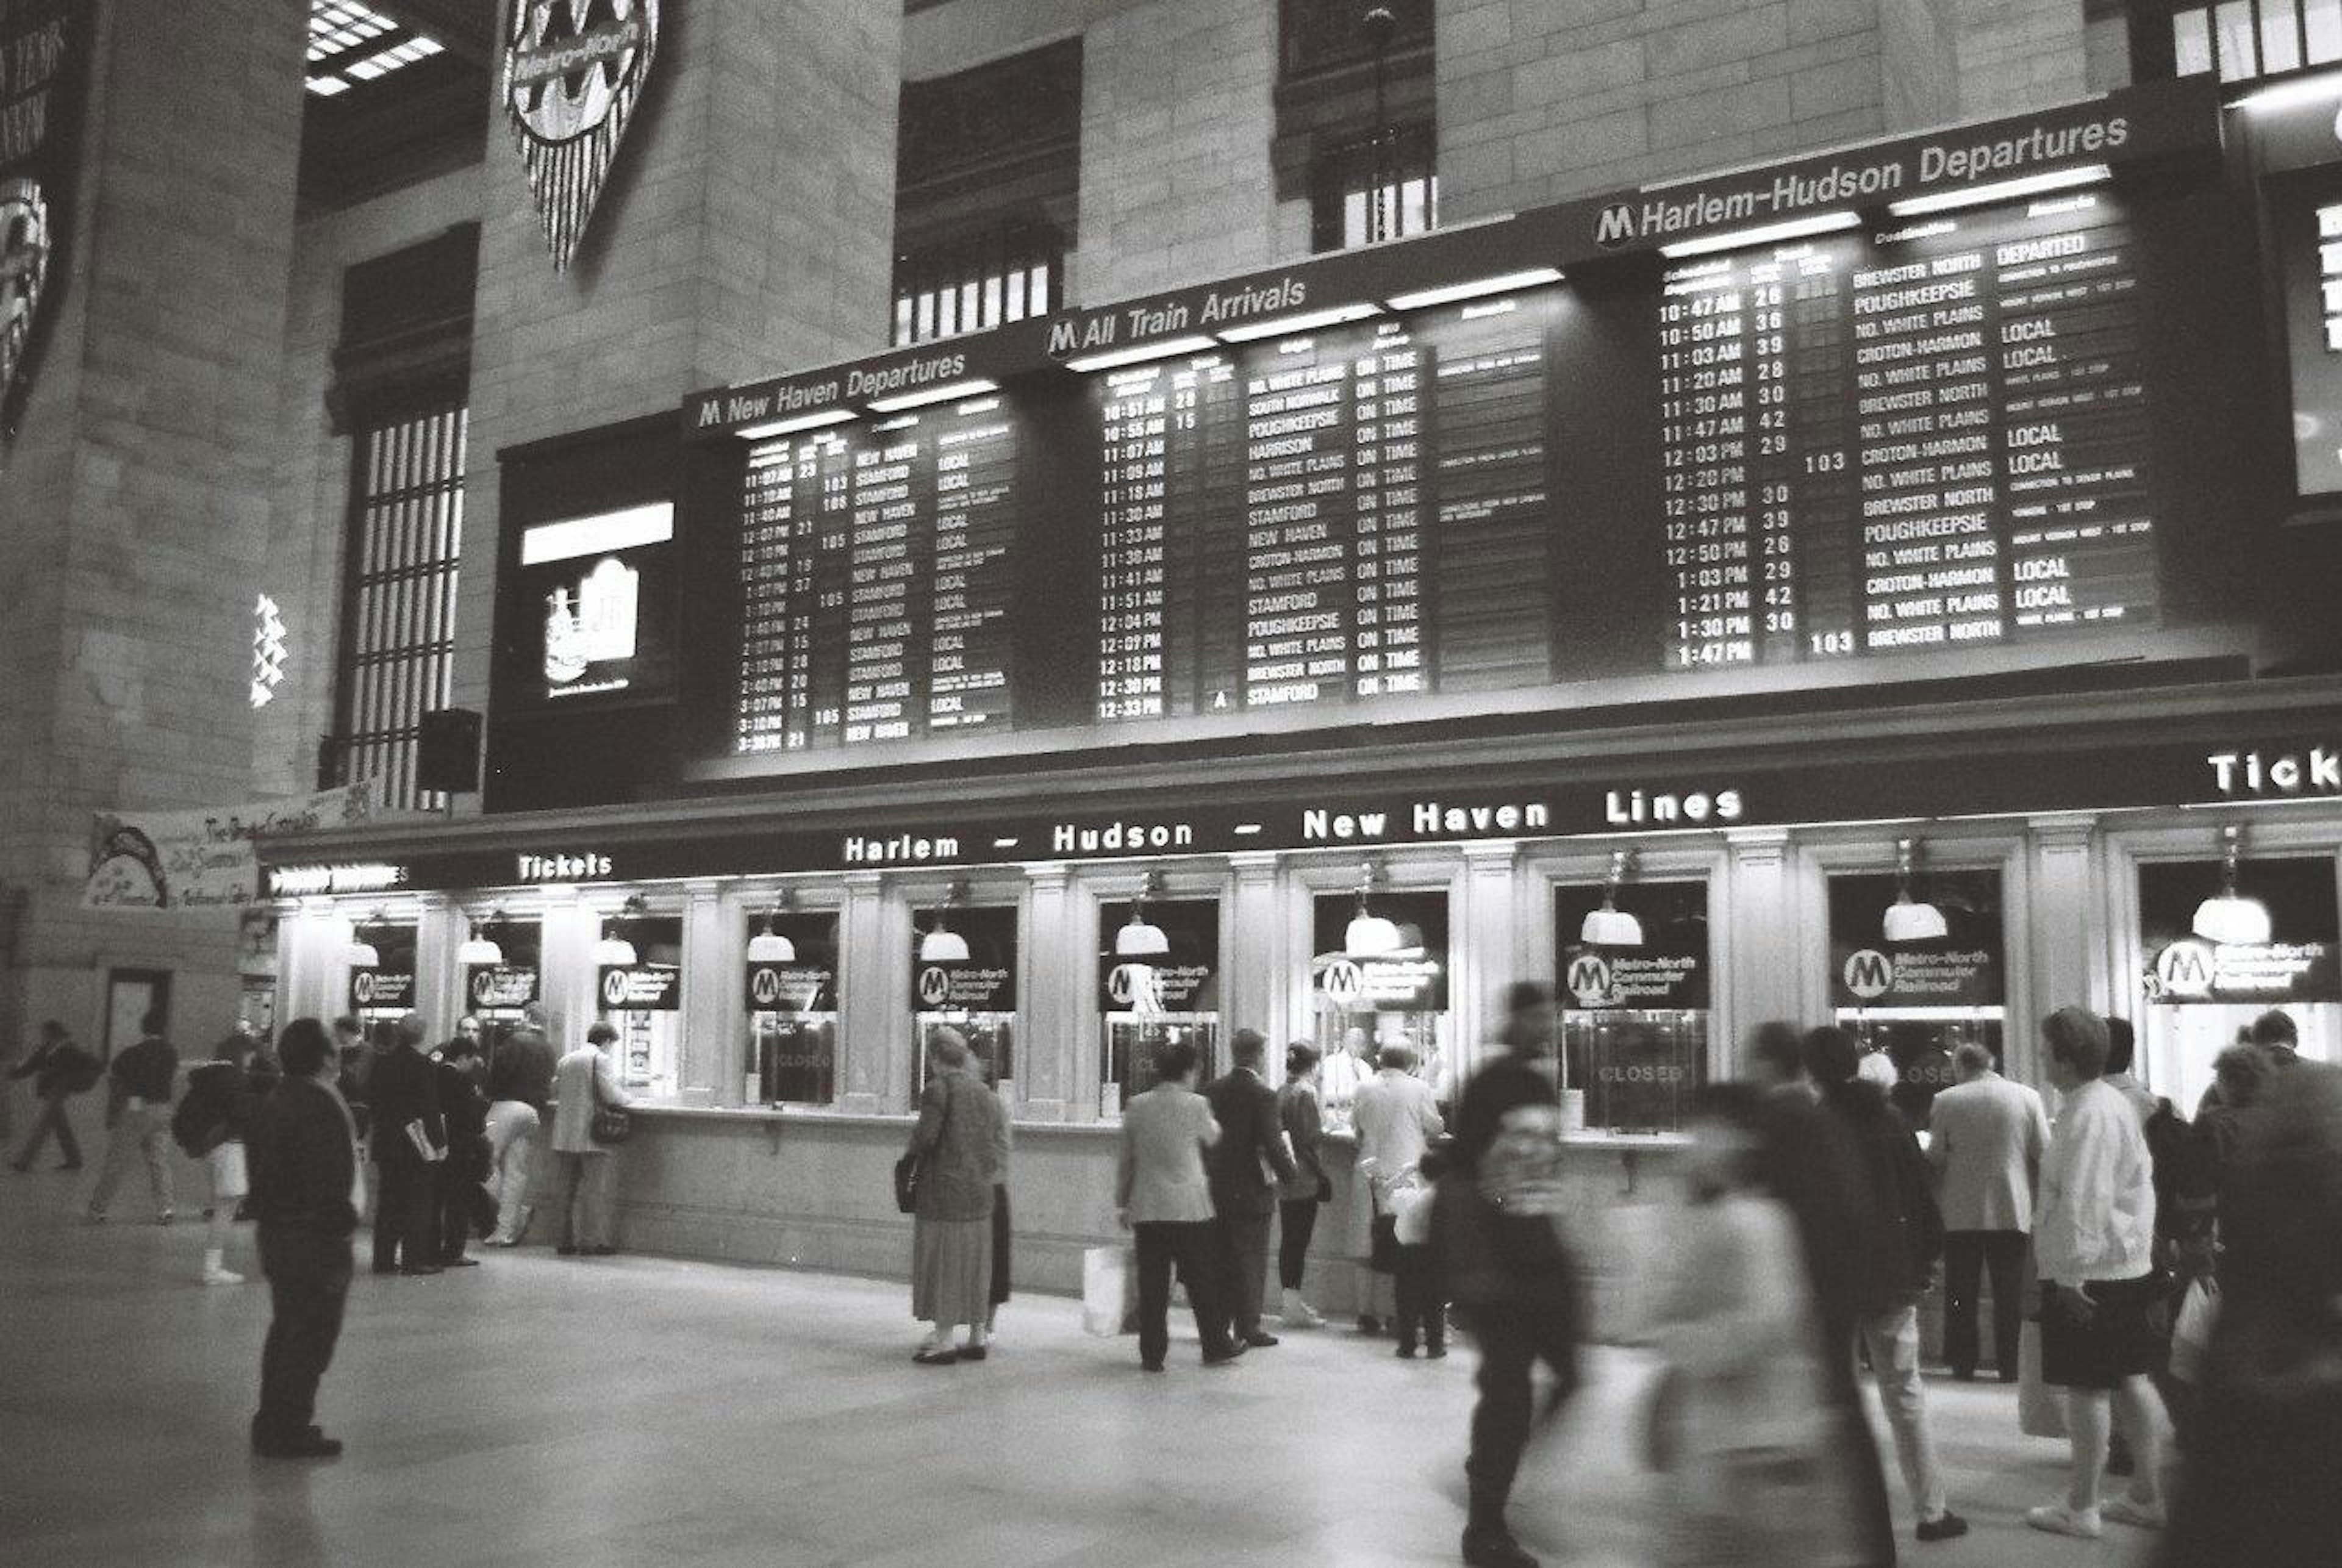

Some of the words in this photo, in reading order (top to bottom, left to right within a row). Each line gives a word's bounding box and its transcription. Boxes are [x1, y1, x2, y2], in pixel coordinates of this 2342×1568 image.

[1641, 167, 1902, 237] Harlem-Hudson
[1921, 118, 2127, 182] Departures
[1661, 298, 1714, 322] 10:47
[1714, 294, 1742, 313] AM
[1755, 285, 1782, 307] 26
[1852, 263, 1930, 287] BREWSTER
[1932, 254, 1982, 275] NORTH
[1997, 235, 2085, 266] DEPARTED
[1082, 315, 1115, 349] All
[1128, 303, 1189, 338] Train
[1200, 278, 1306, 324] Arrivals
[1661, 322, 1714, 345] 10:50
[1716, 318, 1742, 337] AM
[1756, 310, 1782, 331] 36
[1855, 280, 1975, 314] POUGHKEEPSIE
[1662, 347, 1714, 370] 11:03
[1717, 342, 1741, 361] AM
[1757, 335, 1783, 355] 39
[1856, 322, 1880, 338] NO.
[1883, 314, 1928, 334] WHITE
[1933, 305, 1983, 326] PLAINS
[1663, 371, 1715, 393] 11:20
[1718, 367, 1742, 385] AM
[1758, 360, 1783, 379] 28
[1857, 332, 1982, 363] CROTON-HARMON
[2001, 319, 2056, 343] LOCAL
[728, 396, 770, 422] New
[777, 381, 839, 412] Haven
[847, 354, 965, 397] Departures
[1176, 391, 1196, 409] 28
[1663, 396, 1715, 418] 11:30
[1719, 392, 1742, 410] AM
[1760, 385, 1784, 404] 30
[1858, 373, 1882, 388] NO.
[1885, 365, 1930, 384] WHITE
[1936, 357, 1986, 377] PLAINS
[2003, 346, 2057, 368] LOCAL
[1105, 442, 1144, 462] 11:07
[1145, 440, 1164, 456] AM
[1249, 409, 1338, 438] POUGHKEEPSIE
[1357, 404, 1377, 420] ON
[1384, 396, 1416, 415] TIME
[1176, 413, 1195, 429] 15
[1285, 388, 1342, 410] NORWALK
[1664, 420, 1716, 442] 11:47
[1719, 417, 1744, 434] AM
[1760, 410, 1785, 428] 42
[1860, 390, 1932, 414] BREWSTER
[1939, 383, 1987, 403] NORTH
[1249, 436, 1312, 460] HARRISON
[1665, 444, 1717, 467] 12:03
[1721, 441, 1743, 459] PM
[1761, 435, 1786, 454] 29
[1861, 424, 1885, 438] NO.
[1888, 416, 1933, 435] WHITE
[1939, 409, 1989, 428] PLAINS
[1806, 452, 1844, 473] 103
[1862, 435, 1987, 465] CROTON-HARMON
[2007, 424, 2062, 448] LOCAL
[1763, 485, 1788, 504] 30
[1863, 474, 1886, 490] NO.
[1889, 468, 1935, 487] WHITE
[1941, 461, 1992, 481] PLAINS
[2008, 451, 2063, 474] LOCAL
[1249, 503, 1316, 525] STAMFORD
[1667, 519, 1719, 540] 12:47
[1724, 516, 1746, 534] PM
[1763, 510, 1788, 529] 39
[1864, 493, 1938, 516] BREWSTER
[1944, 487, 1994, 507] NORTH
[1249, 530, 1278, 547] NEW
[1285, 524, 1327, 542] HAVEN
[1667, 543, 1721, 565] 12:50
[1725, 541, 1746, 558] PM
[1765, 535, 1789, 554] 26
[1866, 514, 1987, 542] POUGHKEEPSIE
[1678, 568, 1721, 588] 1:03
[1725, 566, 1747, 584] PM
[1765, 561, 1791, 579] 29
[1866, 552, 1890, 567] NO.
[1893, 546, 1939, 564] WHITE
[1945, 542, 1996, 559] PLAINS
[2013, 558, 2069, 581] LOCAL
[1101, 614, 1141, 632] 12:04
[1144, 612, 1161, 626] PM
[1249, 592, 1317, 614] STAMFORD
[1358, 585, 1378, 602] ON
[1385, 580, 1418, 598] TIME
[1102, 592, 1141, 610] 11:51
[1144, 590, 1162, 605] AM
[1679, 593, 1721, 614] 1:21
[1725, 591, 1749, 609] PM
[1766, 587, 1791, 604] 42
[1867, 568, 1994, 593] CROTON-HARMON
[2016, 585, 2072, 609] LOCAL
[1248, 612, 1339, 637] POUGHKEEPSIE
[1678, 618, 1724, 639] 1:30
[1726, 617, 1750, 634] PM
[1767, 612, 1794, 631] 30
[1868, 603, 1893, 620] NO.
[1895, 599, 1942, 617] WHITE
[1947, 595, 1999, 612] PLAINS
[1101, 657, 1144, 675] 12:18
[1143, 655, 1161, 670] PM
[1248, 645, 1267, 658] NO.
[1269, 640, 1303, 656] WHITE
[1306, 636, 1345, 652] PLAINS
[1811, 631, 1853, 654] 103
[1868, 626, 1944, 646] BREWSTER
[1950, 622, 2001, 639] NORTH
[1358, 654, 1378, 671] ON
[1386, 650, 1420, 668] TIME
[792, 693, 808, 708] 15
[1143, 699, 1161, 714] PM
[1214, 691, 1227, 708] A
[1248, 684, 1317, 705] STAMFORD
[1358, 677, 1380, 695] ON
[1384, 673, 1422, 692] TIME
[2207, 748, 2341, 790] Tick
[845, 836, 958, 861] Harlem
[1054, 822, 1192, 851] Hudson
[1303, 810, 1386, 839] New
[1413, 803, 1548, 833] Haven
[1606, 790, 1742, 823] Lines
[518, 854, 611, 879] Tickets
[951, 968, 1009, 978] Metro-North
[1612, 957, 1696, 970] Metro-North
[1612, 971, 1686, 981] Commuter
[1894, 951, 1988, 965] Metro-North
[1894, 965, 1977, 977] Commuter
[1611, 983, 1669, 995] Railroad
[1893, 978, 1960, 992] Railroad
[1599, 1067, 1683, 1083] CLOSED
